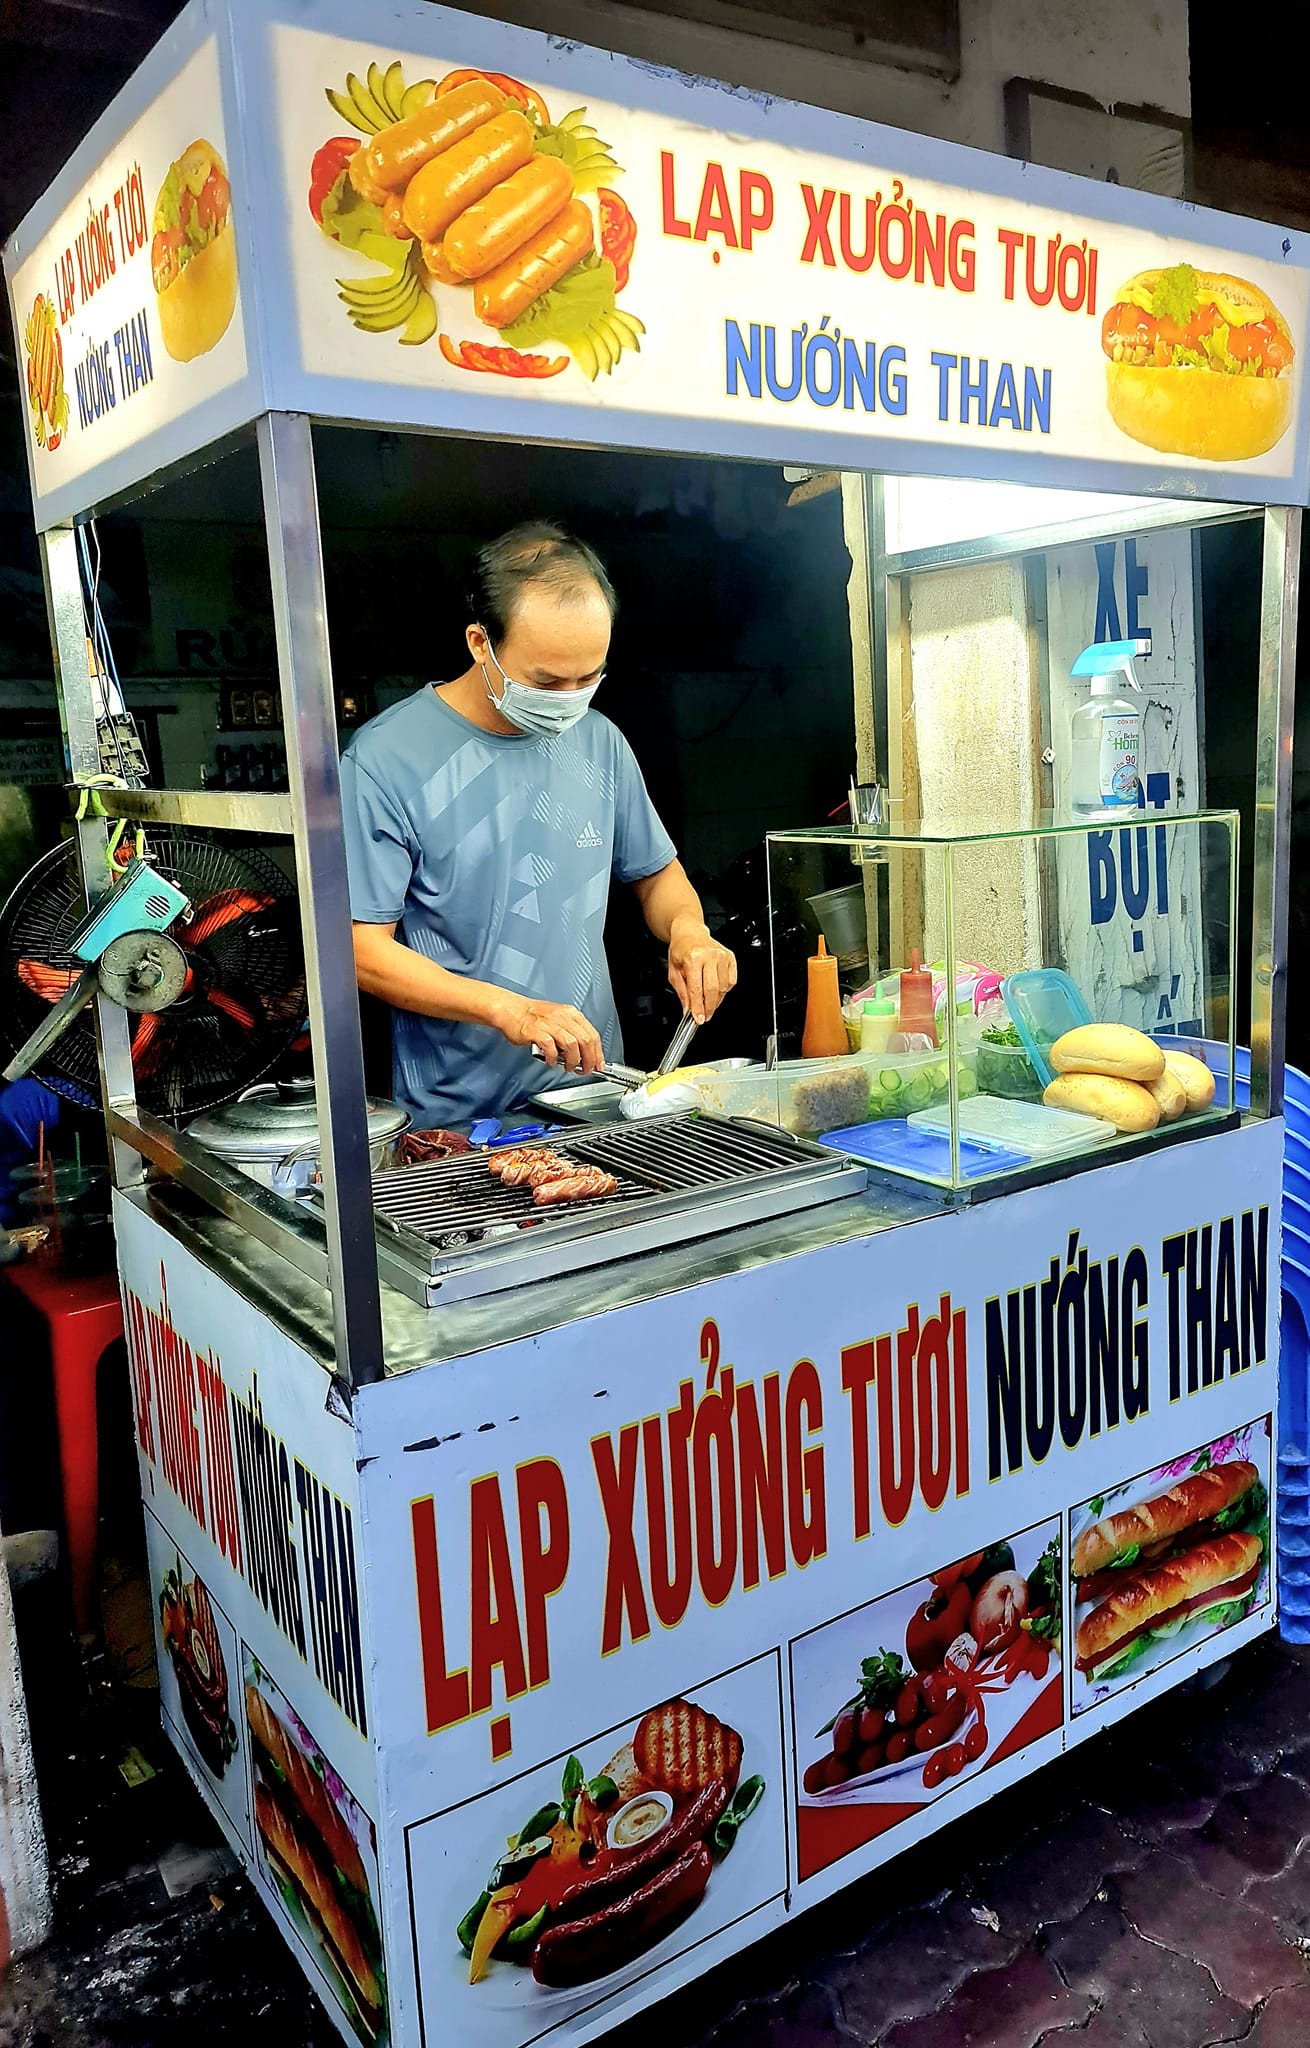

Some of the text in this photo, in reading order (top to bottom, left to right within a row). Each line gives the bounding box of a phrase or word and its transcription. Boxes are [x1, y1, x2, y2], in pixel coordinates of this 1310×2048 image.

[55, 161, 149, 334] LẠP XƯỞNG TƯƠI
[660, 150, 1099, 317] LẠP XƯỞNG TƯƠI
[74, 308, 154, 431] NƯỚNG THAN
[725, 315, 1053, 435] NƯỚNG THAN
[1094, 536, 1153, 656] XE
[1112, 737, 1139, 750] Hom
[146, 1258, 206, 1532] XƯỞNG
[195, 1345, 245, 1578] TƯƠI
[231, 1369, 308, 1664] NƯỚNG
[293, 1455, 369, 1741] THAN
[410, 1203, 1270, 1762] LẠP XƯỞNG TƯƠI NƯỚNG THAN
